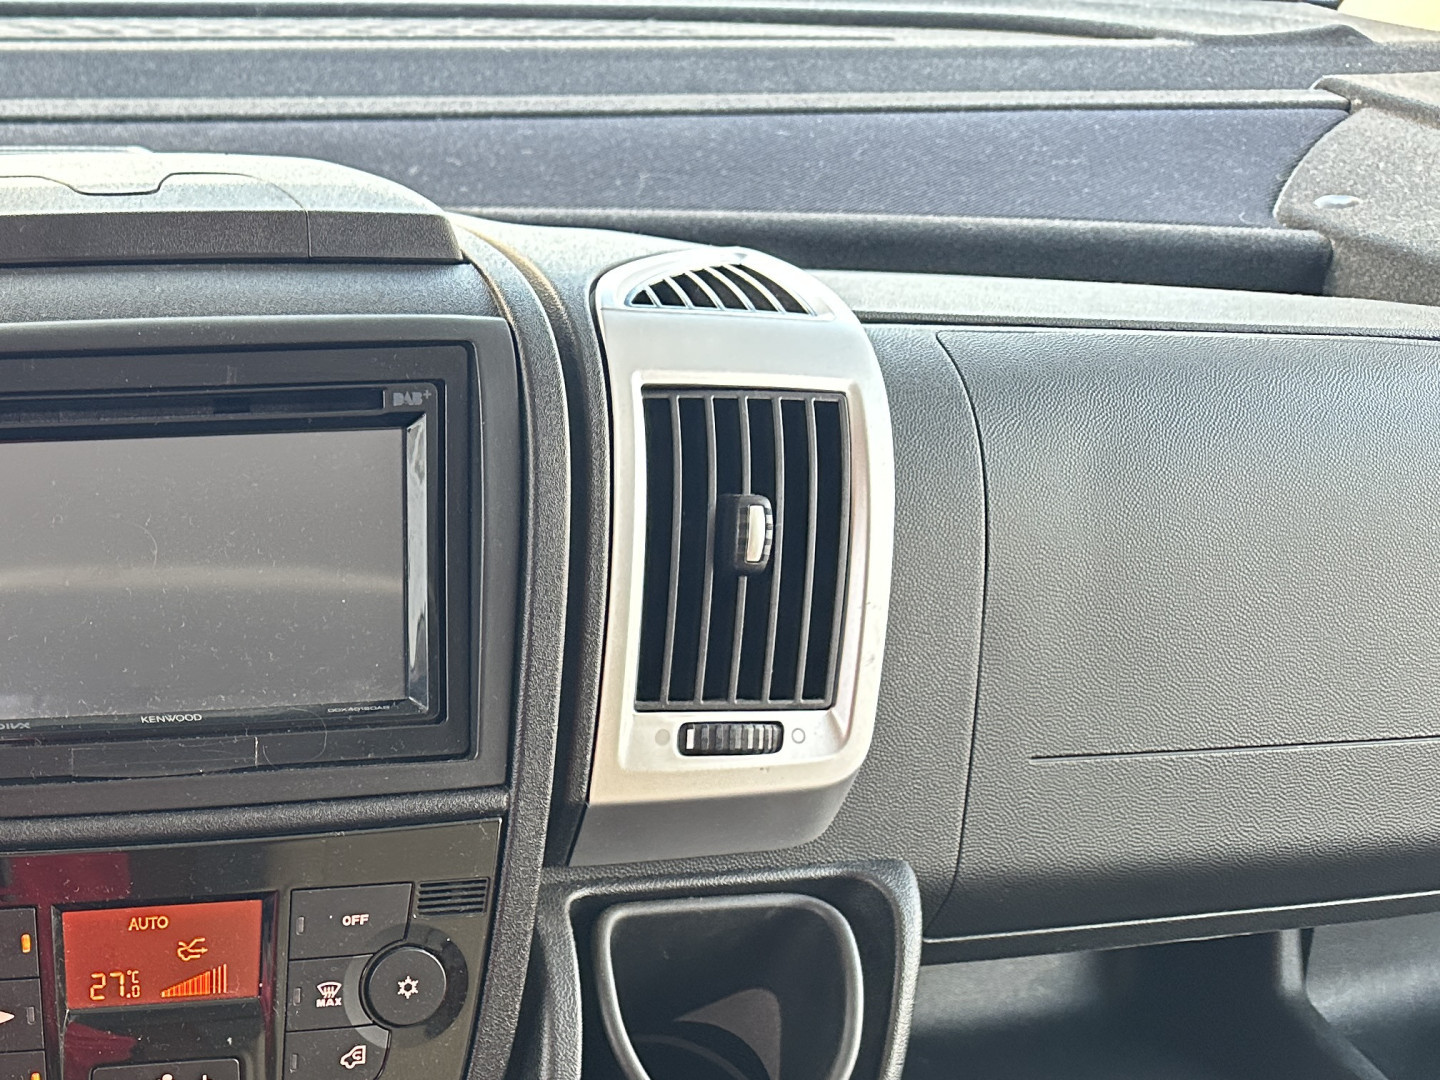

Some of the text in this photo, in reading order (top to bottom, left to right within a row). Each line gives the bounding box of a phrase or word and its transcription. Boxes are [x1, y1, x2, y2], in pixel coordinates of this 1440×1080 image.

[140, 712, 203, 724] KENWOOD
[128, 916, 169, 931] AUTO
[342, 914, 370, 926] OFF
[316, 998, 342, 1008] MAX
